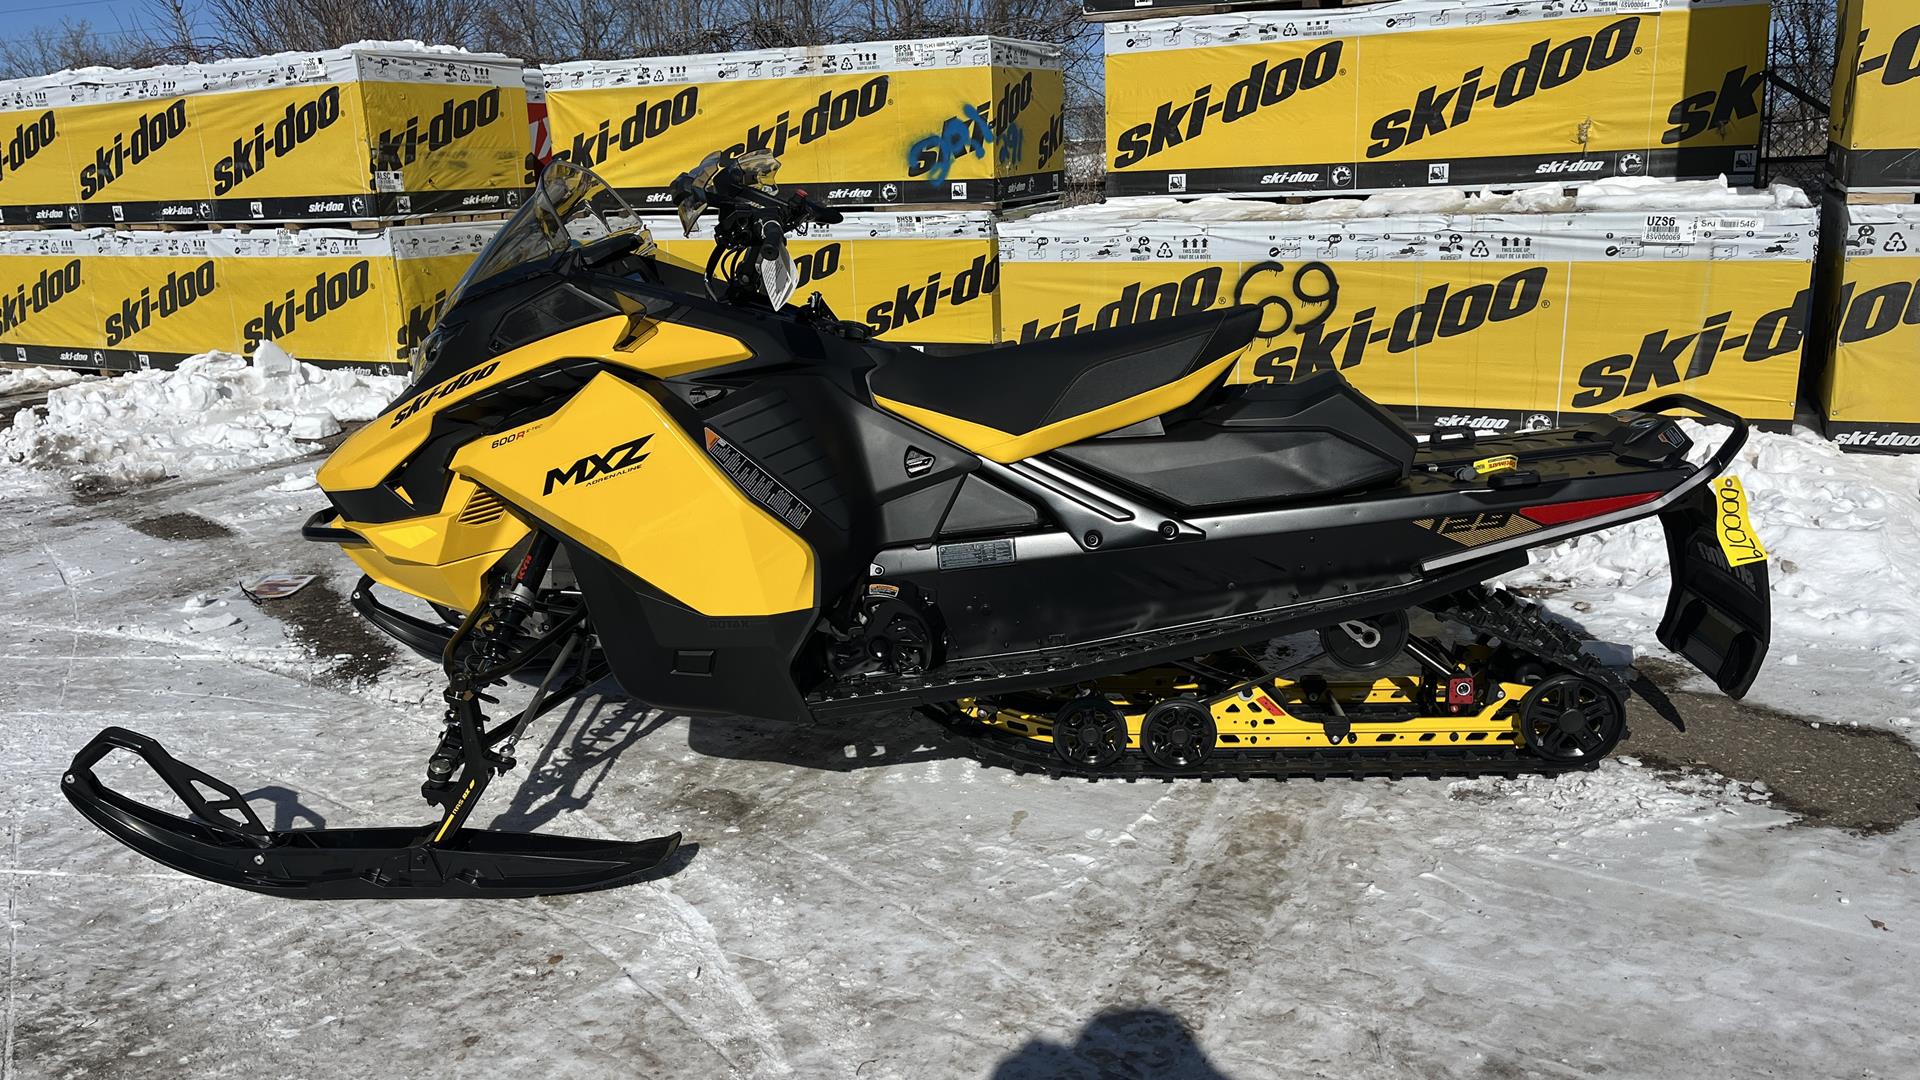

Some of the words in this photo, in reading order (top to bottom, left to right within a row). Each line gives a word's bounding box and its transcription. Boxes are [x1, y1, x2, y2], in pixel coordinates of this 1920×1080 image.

[1366, 16, 1641, 159] ski-doo
[1114, 41, 1344, 169] ski-doo
[80, 99, 186, 201] ski-doo
[213, 86, 340, 196] ski-doo
[1535, 160, 1605, 173] ski-doo
[1260, 172, 1319, 184] ski-doo
[462, 194, 500, 205] ski-doo
[828, 188, 872, 199] ski-doo
[36, 209, 64, 219] ski-doo
[308, 202, 345, 213] ski-doo
[1647, 216, 1676, 226] UZS6
[1740, 220, 1756, 228] 546
[106, 260, 215, 347] ski-doo
[243, 260, 369, 354] ski-doo
[1254, 267, 1548, 384] ski-doo
[60, 352, 88, 361] ski-doo
[390, 361, 501, 429] ski-doo
[1434, 415, 1509, 429] ski-doo
[542, 432, 656, 496] MXZ
[585, 464, 643, 487] ADRENALINE
